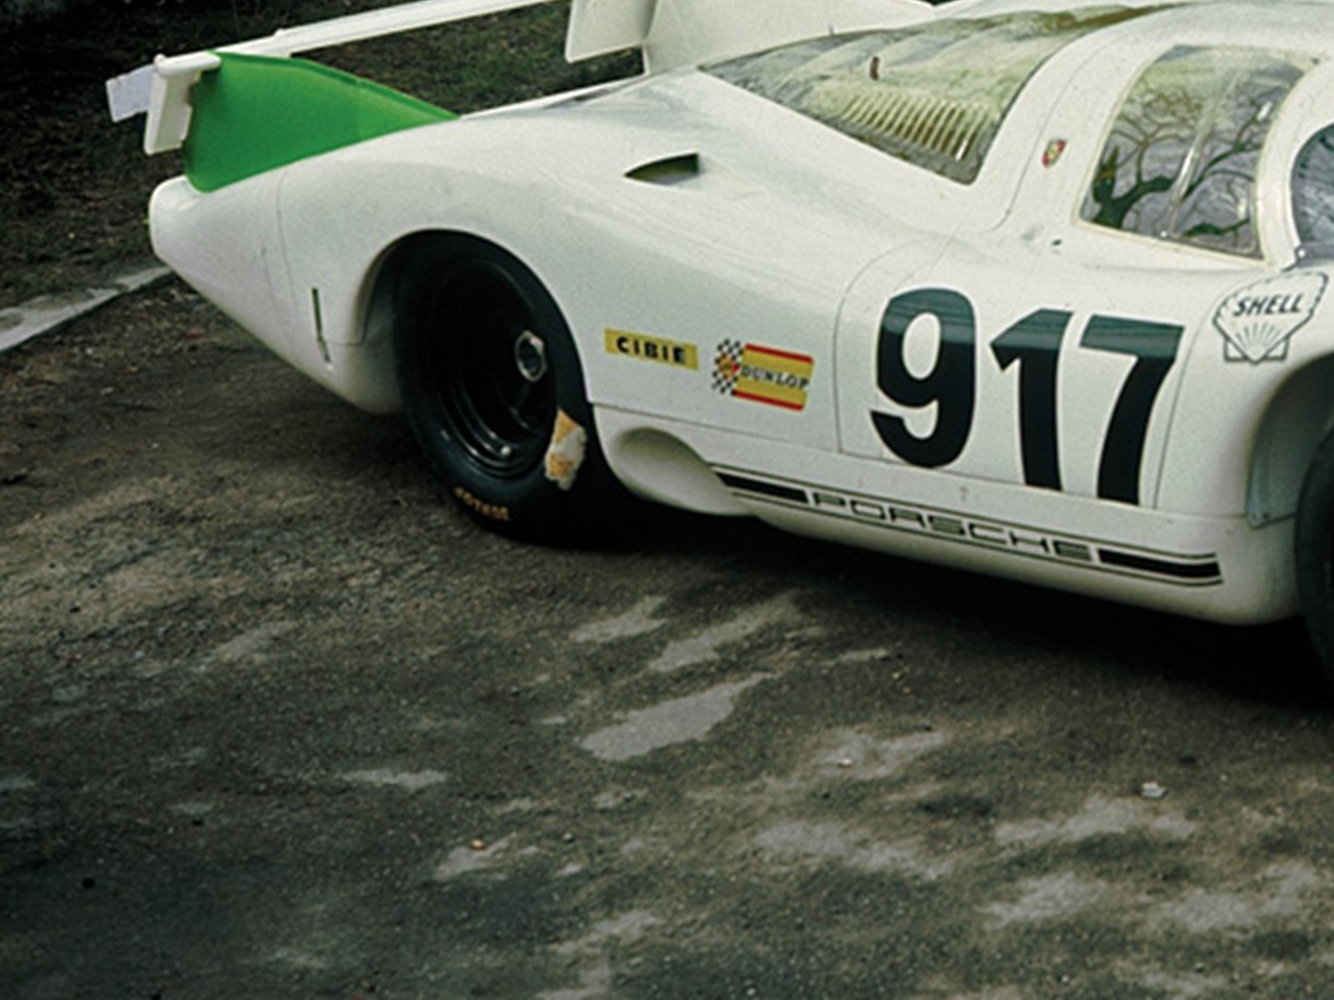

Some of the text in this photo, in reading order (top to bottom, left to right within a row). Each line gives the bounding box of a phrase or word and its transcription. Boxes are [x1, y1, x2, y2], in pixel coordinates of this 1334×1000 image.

[1232, 292, 1303, 317] SHELL
[616, 336, 687, 364] CIBIE
[740, 363, 810, 390] DUNLOP
[871, 288, 1186, 505] 917
[811, 492, 1092, 561] PORSCHE
